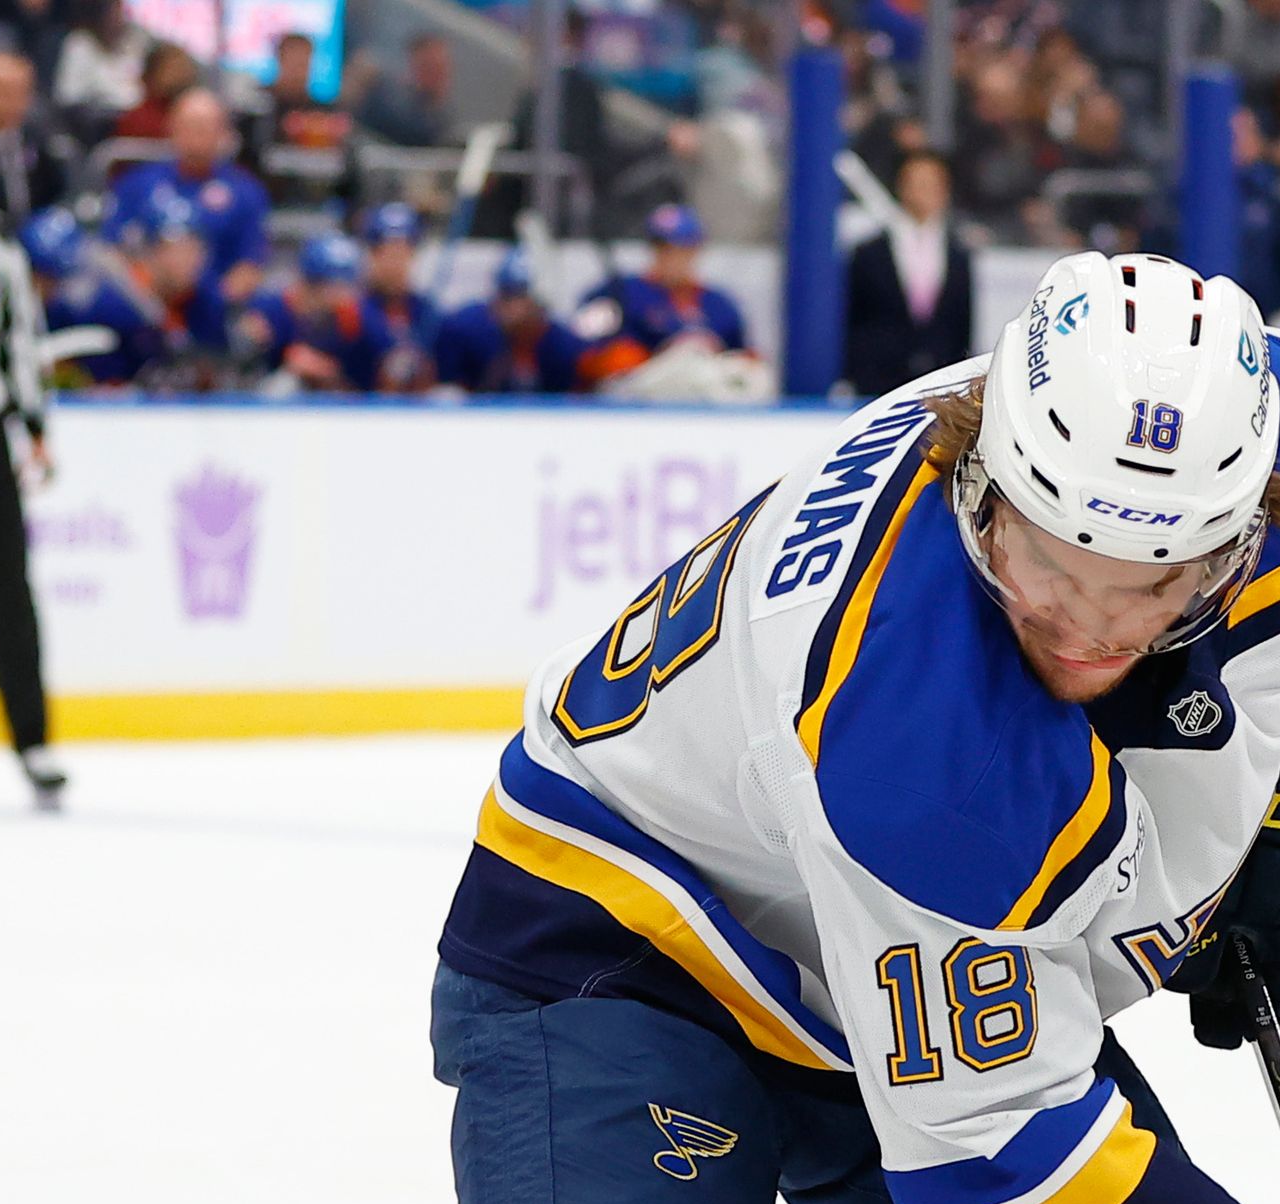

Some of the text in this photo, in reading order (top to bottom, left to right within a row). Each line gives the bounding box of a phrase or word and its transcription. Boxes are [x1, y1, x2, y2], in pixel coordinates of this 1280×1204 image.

[1125, 398, 1184, 454] 18
[766, 392, 932, 600] HOMAS
[1086, 496, 1184, 527] CCM
[1185, 698, 1206, 732] NHL
[876, 934, 1040, 1087] 18
